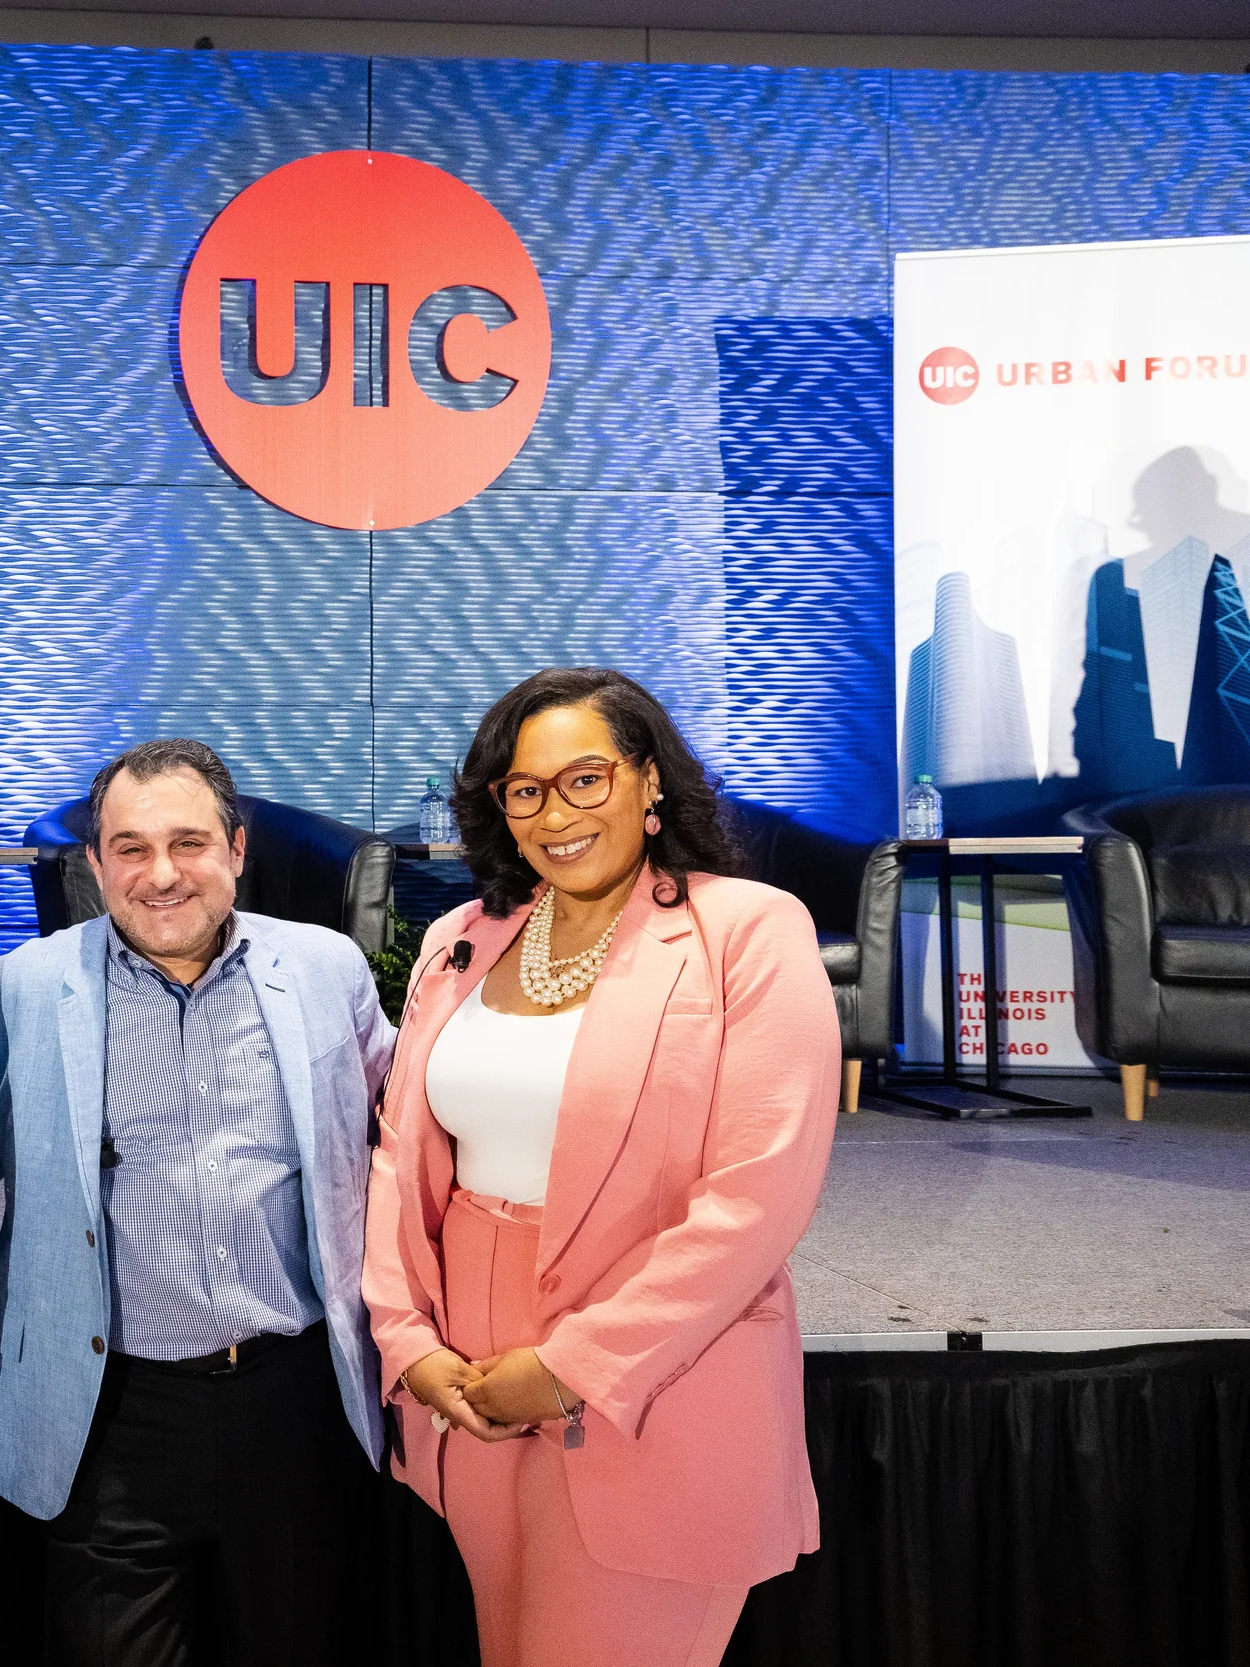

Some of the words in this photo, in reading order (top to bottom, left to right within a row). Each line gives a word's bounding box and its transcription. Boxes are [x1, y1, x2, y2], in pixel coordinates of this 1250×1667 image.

[219, 278, 520, 412] UIC
[922, 364, 977, 390] UIC
[996, 359, 1126, 387] URBAN
[1145, 354, 1248, 381] FORU
[958, 973, 982, 986] TH
[959, 990, 1076, 1003] UNVERSITY
[959, 1008, 1047, 1021] ILLNOIS
[959, 1025, 982, 1038] AT
[959, 1042, 1049, 1056] CHCAGO
